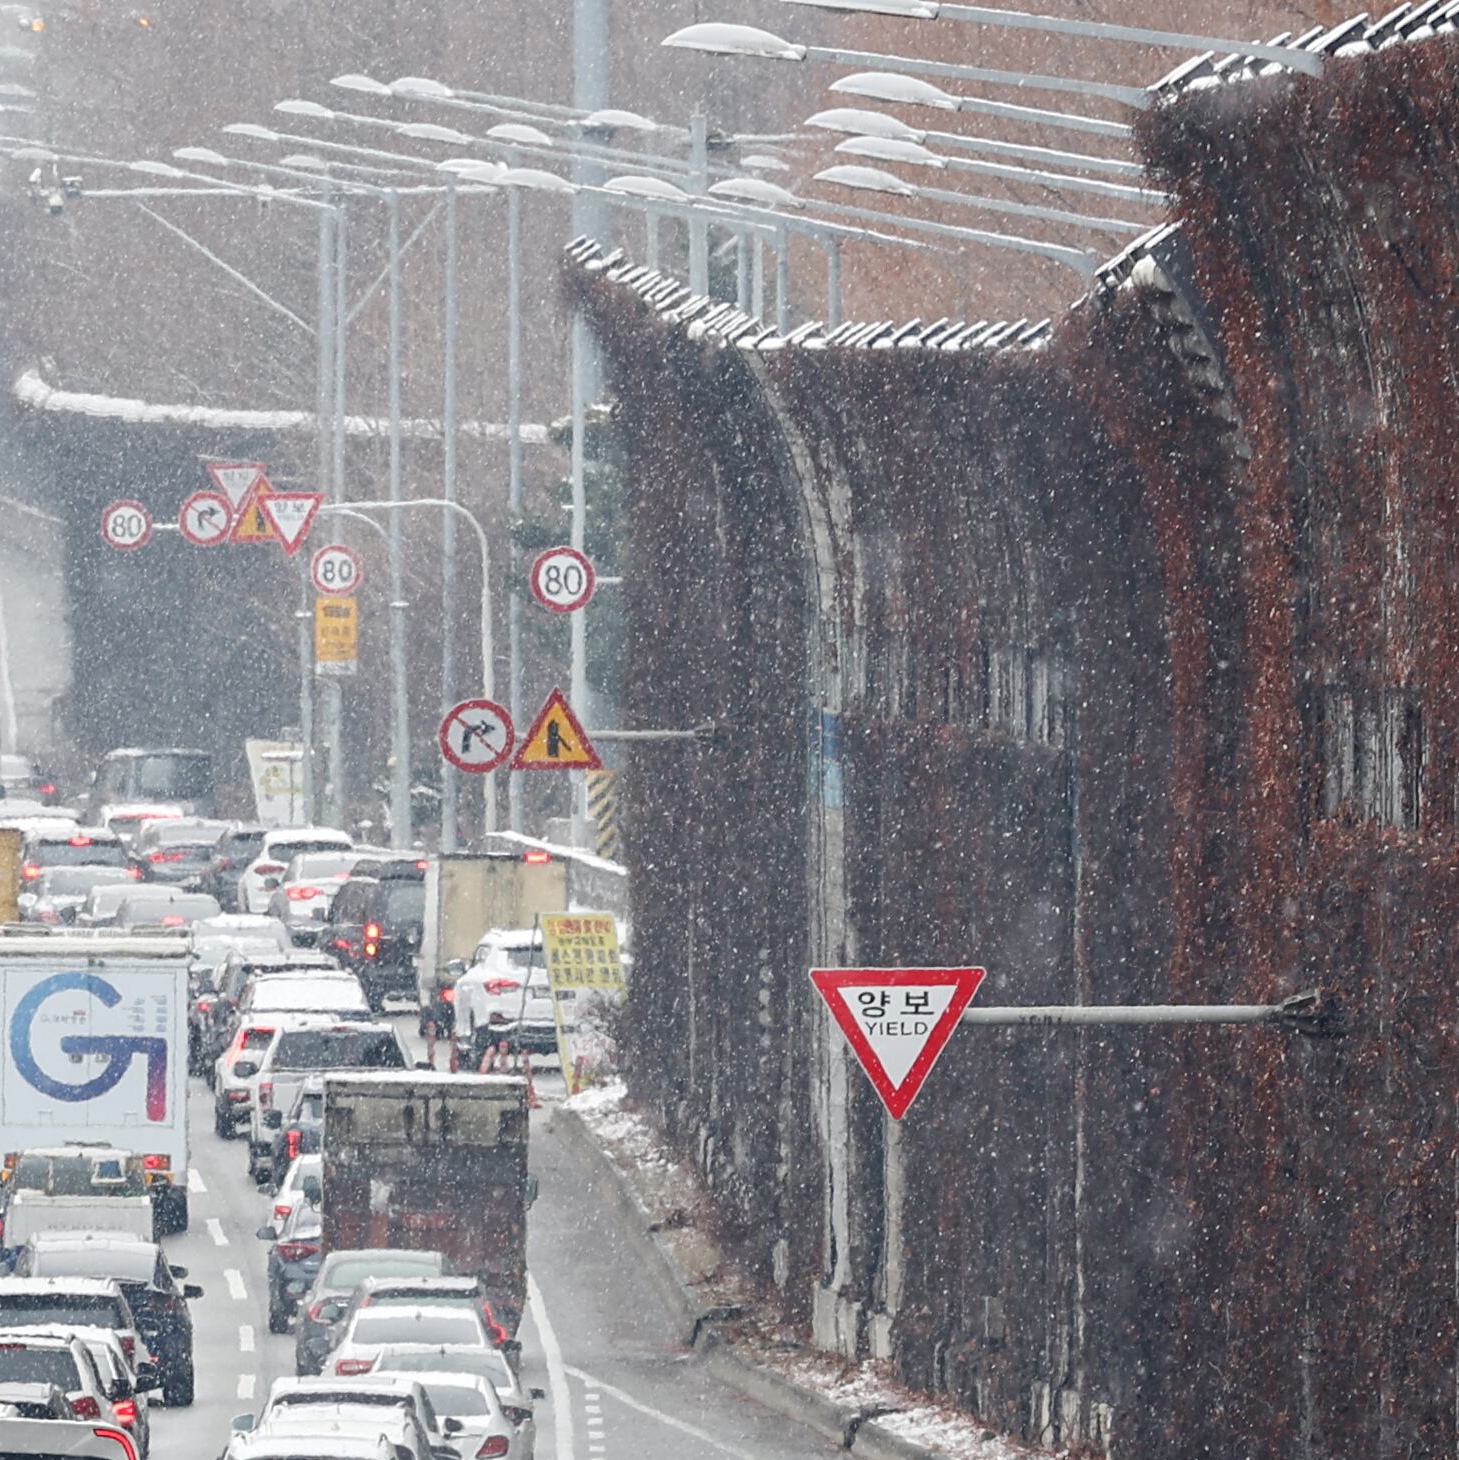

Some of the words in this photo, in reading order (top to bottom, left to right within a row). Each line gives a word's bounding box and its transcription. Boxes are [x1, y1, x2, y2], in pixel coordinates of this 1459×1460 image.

[112, 515, 142, 538] 80
[323, 560, 352, 582] 80
[545, 565, 582, 595] 80
[858, 991, 935, 1017] 양보
[865, 1020, 929, 1036] YIELD
